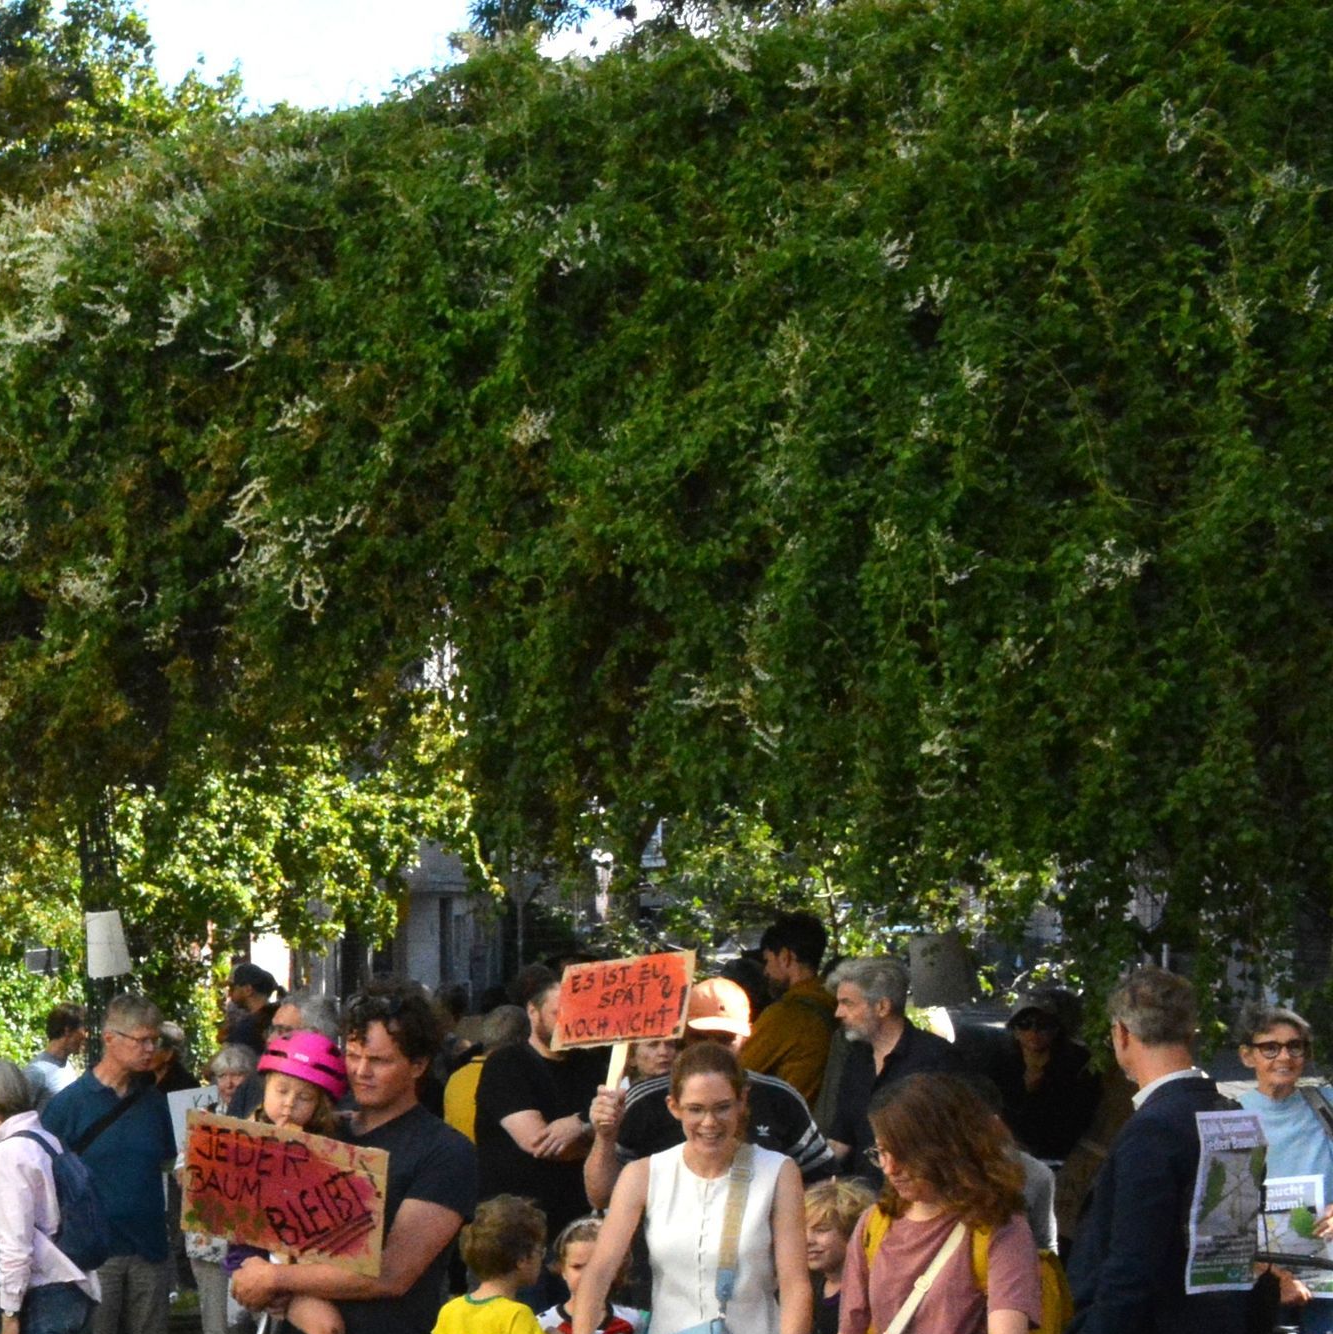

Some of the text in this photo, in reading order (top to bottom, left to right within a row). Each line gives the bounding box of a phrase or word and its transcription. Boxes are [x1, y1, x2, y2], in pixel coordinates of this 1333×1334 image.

[572, 972, 595, 994] ES
[196, 1125, 310, 1177] JEDER
[186, 1163, 262, 1206] BAUM
